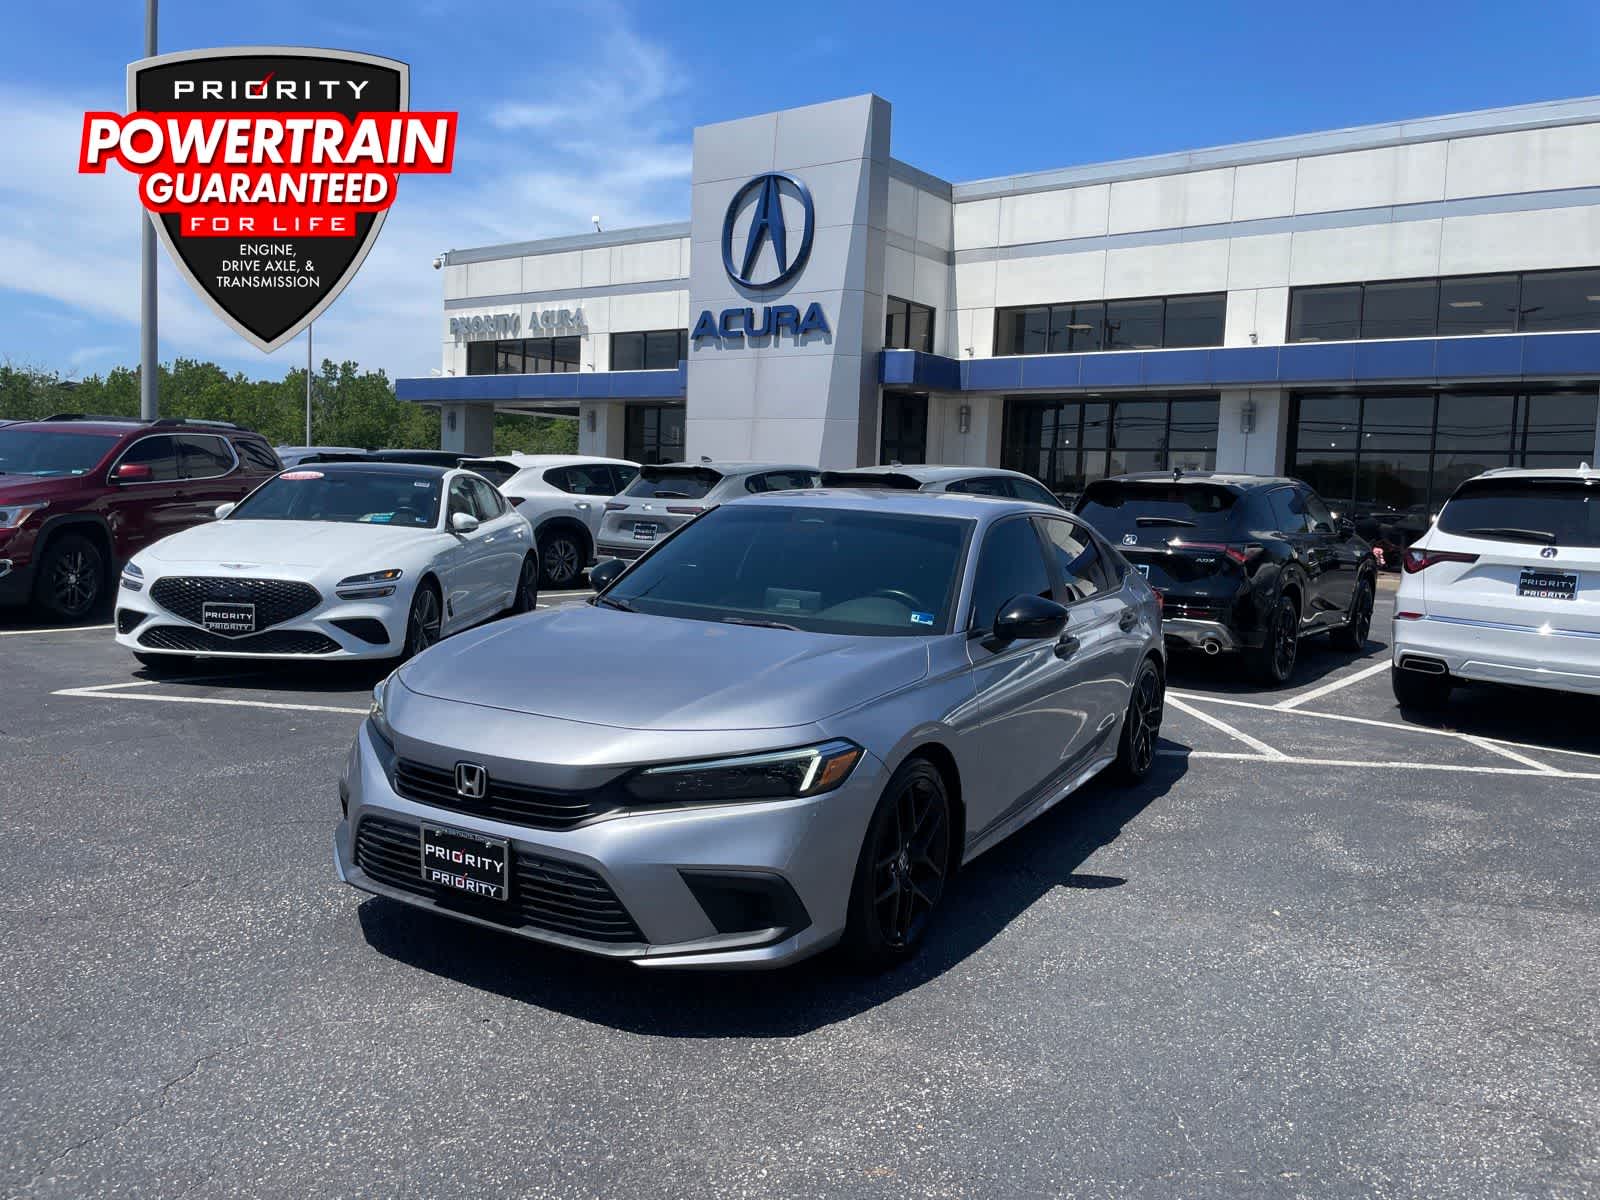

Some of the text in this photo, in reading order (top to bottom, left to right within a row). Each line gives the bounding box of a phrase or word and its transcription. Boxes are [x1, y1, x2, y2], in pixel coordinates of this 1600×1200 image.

[450, 307, 586, 334] PRIORITY ACURA
[690, 302, 832, 341] ACURA
[1520, 578, 1576, 589] PRIORITY
[1523, 590, 1570, 599] PRIORITY
[205, 611, 253, 621] PRIORITY
[209, 622, 249, 631] PRIORITY
[425, 843, 504, 873] PRIORITY
[432, 871, 497, 897] PRIORITY
